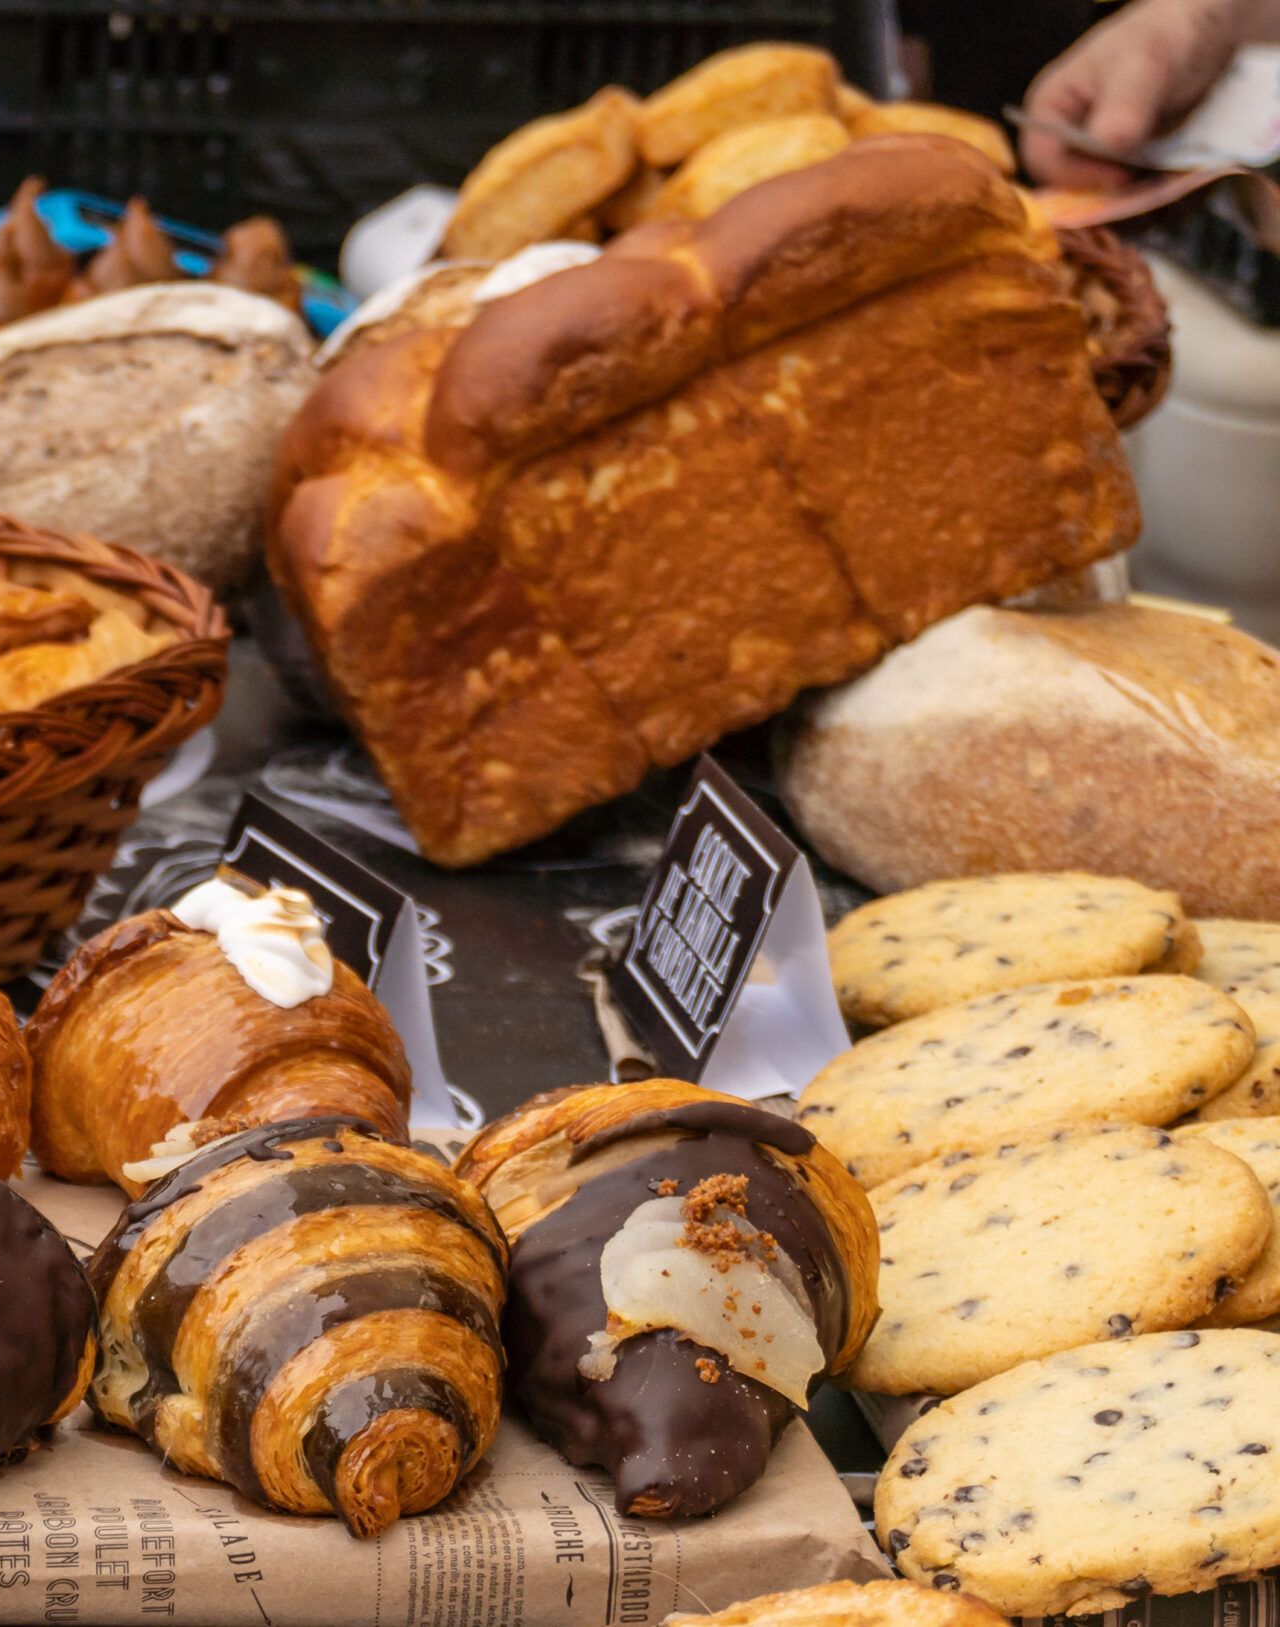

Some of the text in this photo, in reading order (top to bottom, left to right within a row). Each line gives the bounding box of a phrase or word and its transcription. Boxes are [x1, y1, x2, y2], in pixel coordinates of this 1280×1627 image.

[88, 1506, 130, 1591] POULET
[195, 1507, 264, 1584] SALADE
[448, 1534, 458, 1544] un
[472, 1525, 484, 1554] corteza
[502, 1540, 512, 1561] pero
[540, 1505, 584, 1564] BRIOCHE
[34, 1492, 80, 1622] JAMBON CRU
[130, 1498, 176, 1616] ROQUEFORT
[409, 1544, 418, 1570] como
[449, 1548, 459, 1584] amarillo
[462, 1545, 472, 1568] color
[476, 1558, 485, 1569] se
[476, 1572, 486, 1592] dora
[502, 1562, 512, 1596] sabroso
[618, 1524, 653, 1624] DESTACADO
